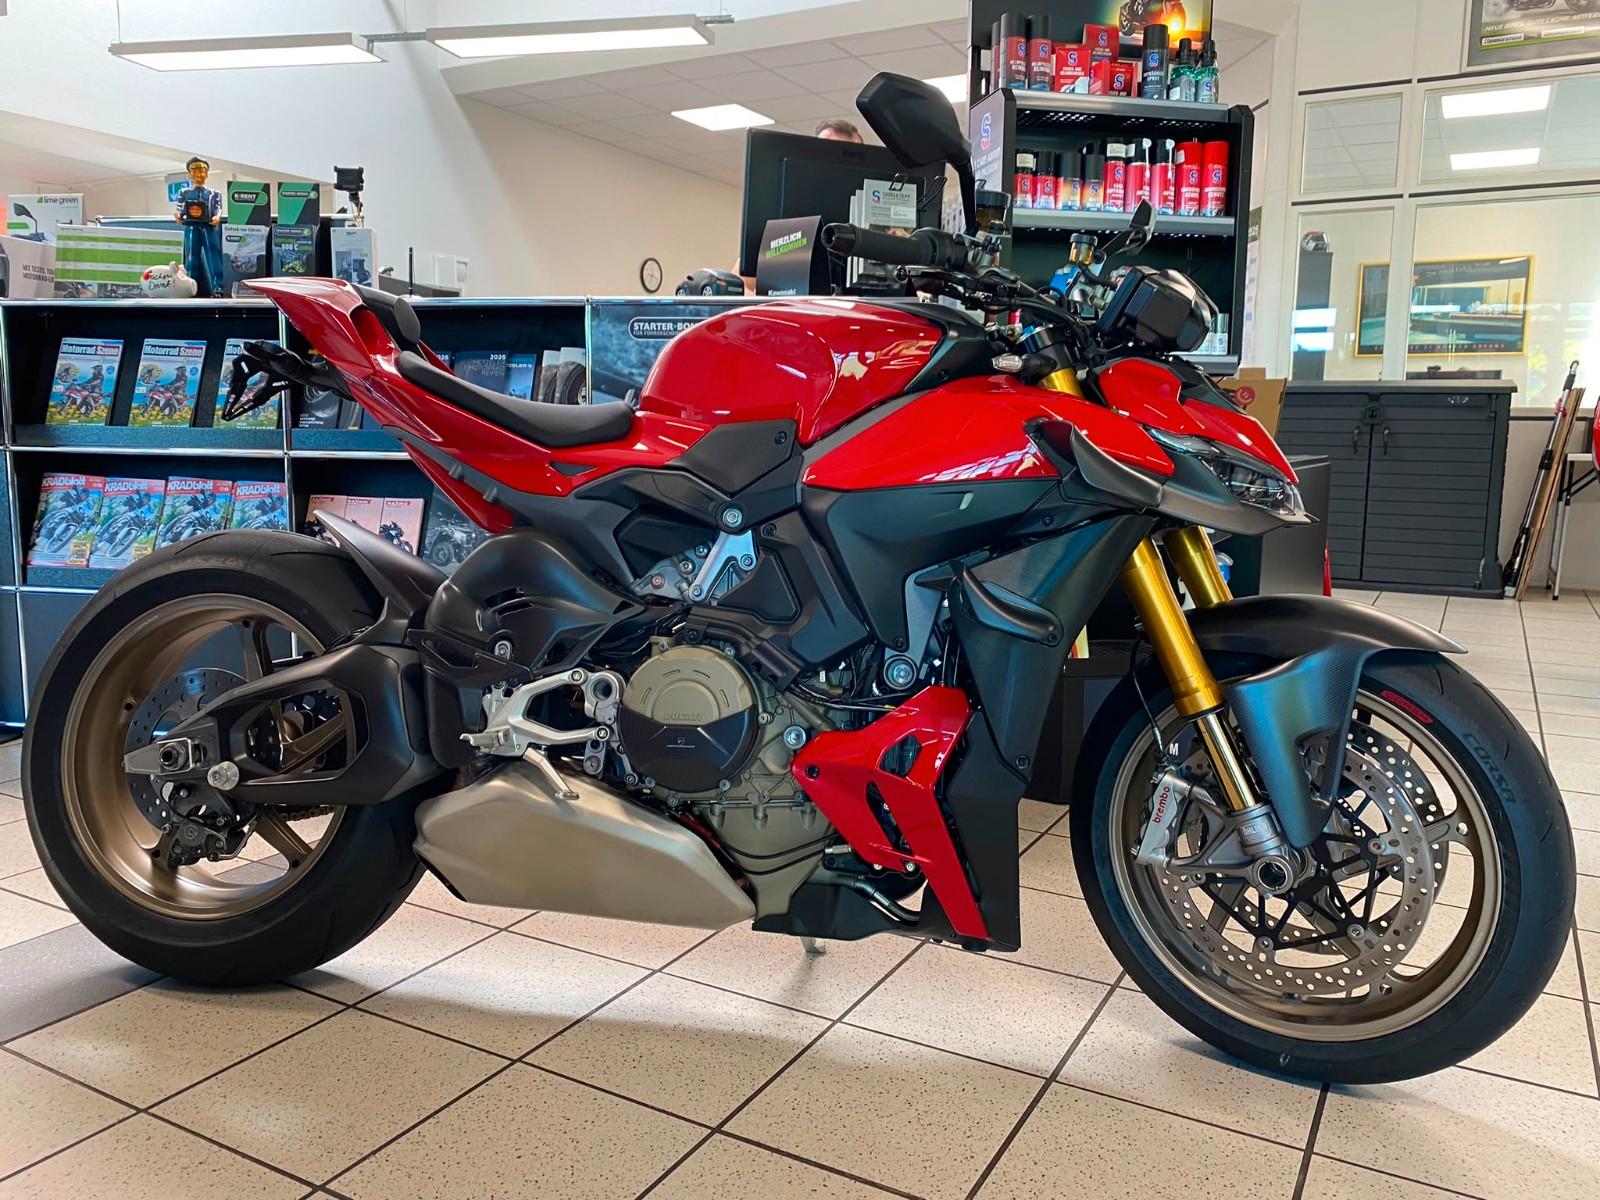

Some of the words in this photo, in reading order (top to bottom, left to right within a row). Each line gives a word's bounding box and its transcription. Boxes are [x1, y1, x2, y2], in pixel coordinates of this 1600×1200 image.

[59, 197, 78, 205] green
[770, 230, 802, 249] HERZLICH
[768, 288, 796, 296] Kawasaki
[61, 343, 96, 354] Motorrad
[96, 345, 119, 356] Szene
[143, 345, 179, 355] Motorrad
[179, 347, 203, 357] Szene
[1169, 743, 1179, 756] M
[1463, 733, 1516, 803] CORSA
[1152, 786, 1170, 823] brembo
